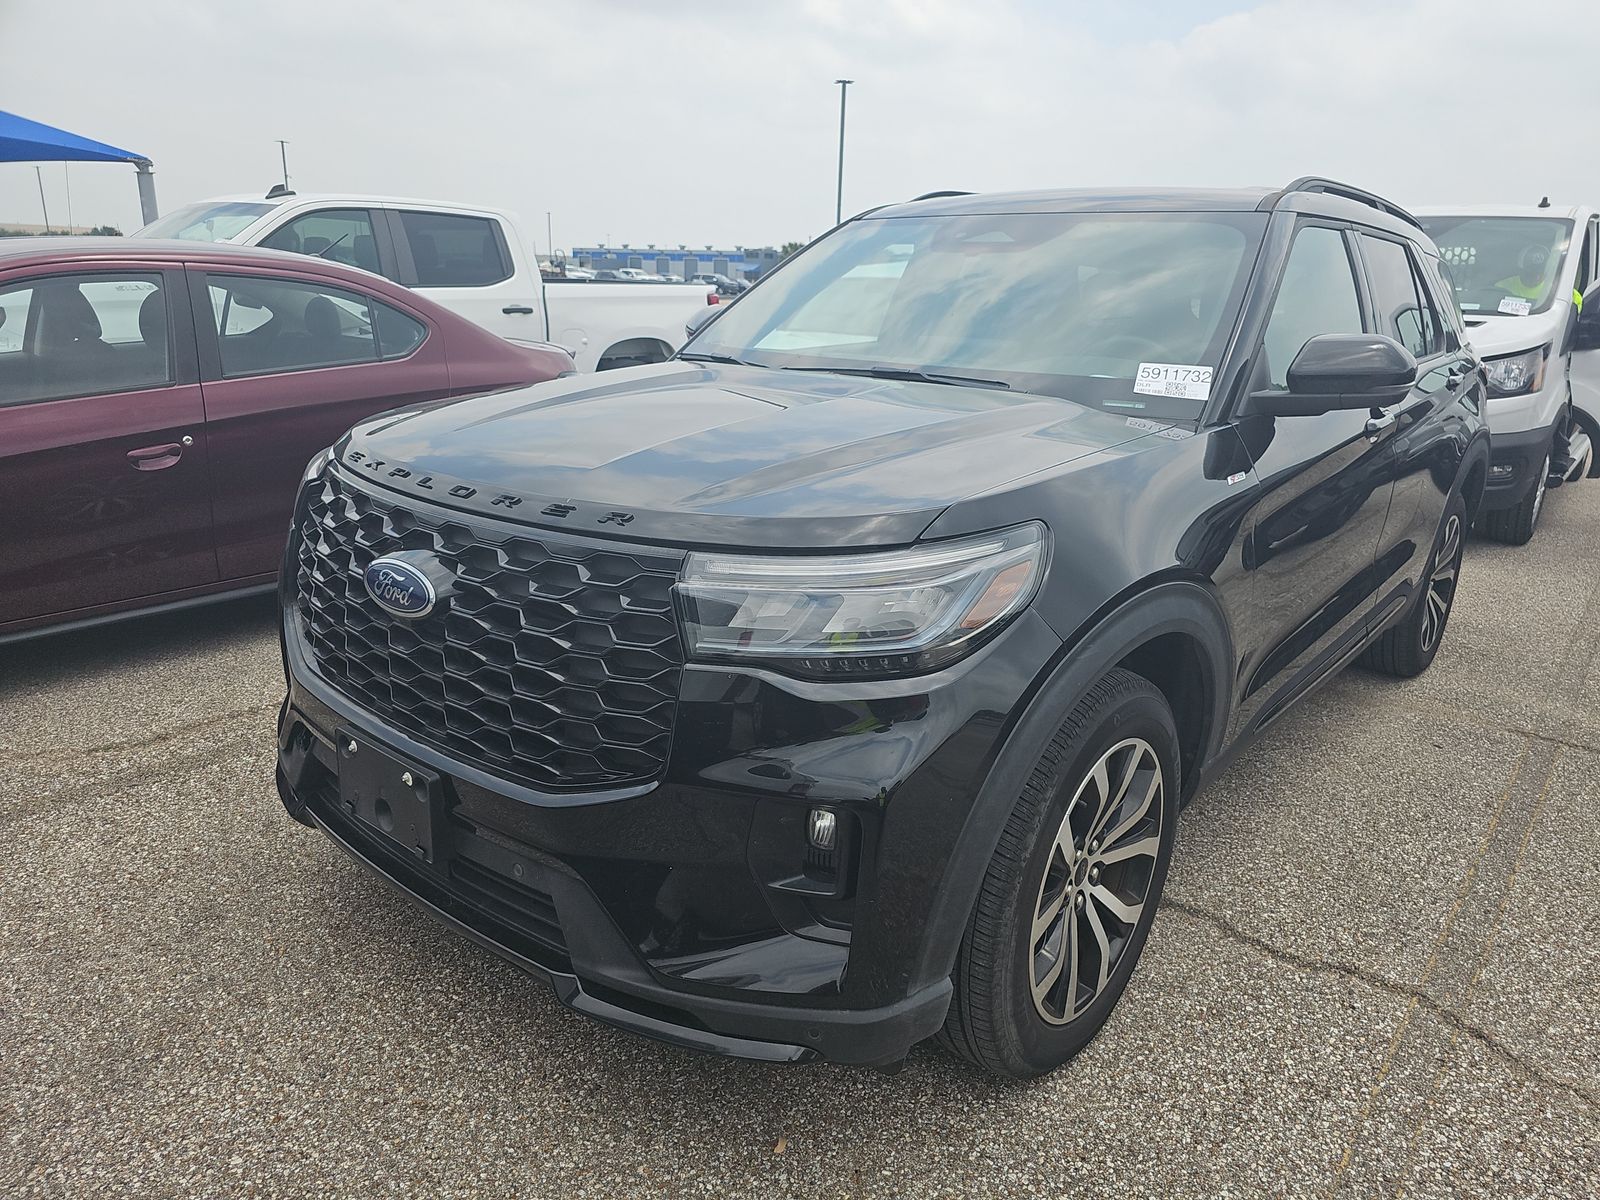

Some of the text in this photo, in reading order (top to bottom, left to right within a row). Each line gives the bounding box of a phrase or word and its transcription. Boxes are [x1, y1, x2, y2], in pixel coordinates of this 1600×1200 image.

[1140, 366, 1212, 384] 5911732
[349, 451, 635, 527] EXPLORER
[374, 569, 414, 606] Ford
